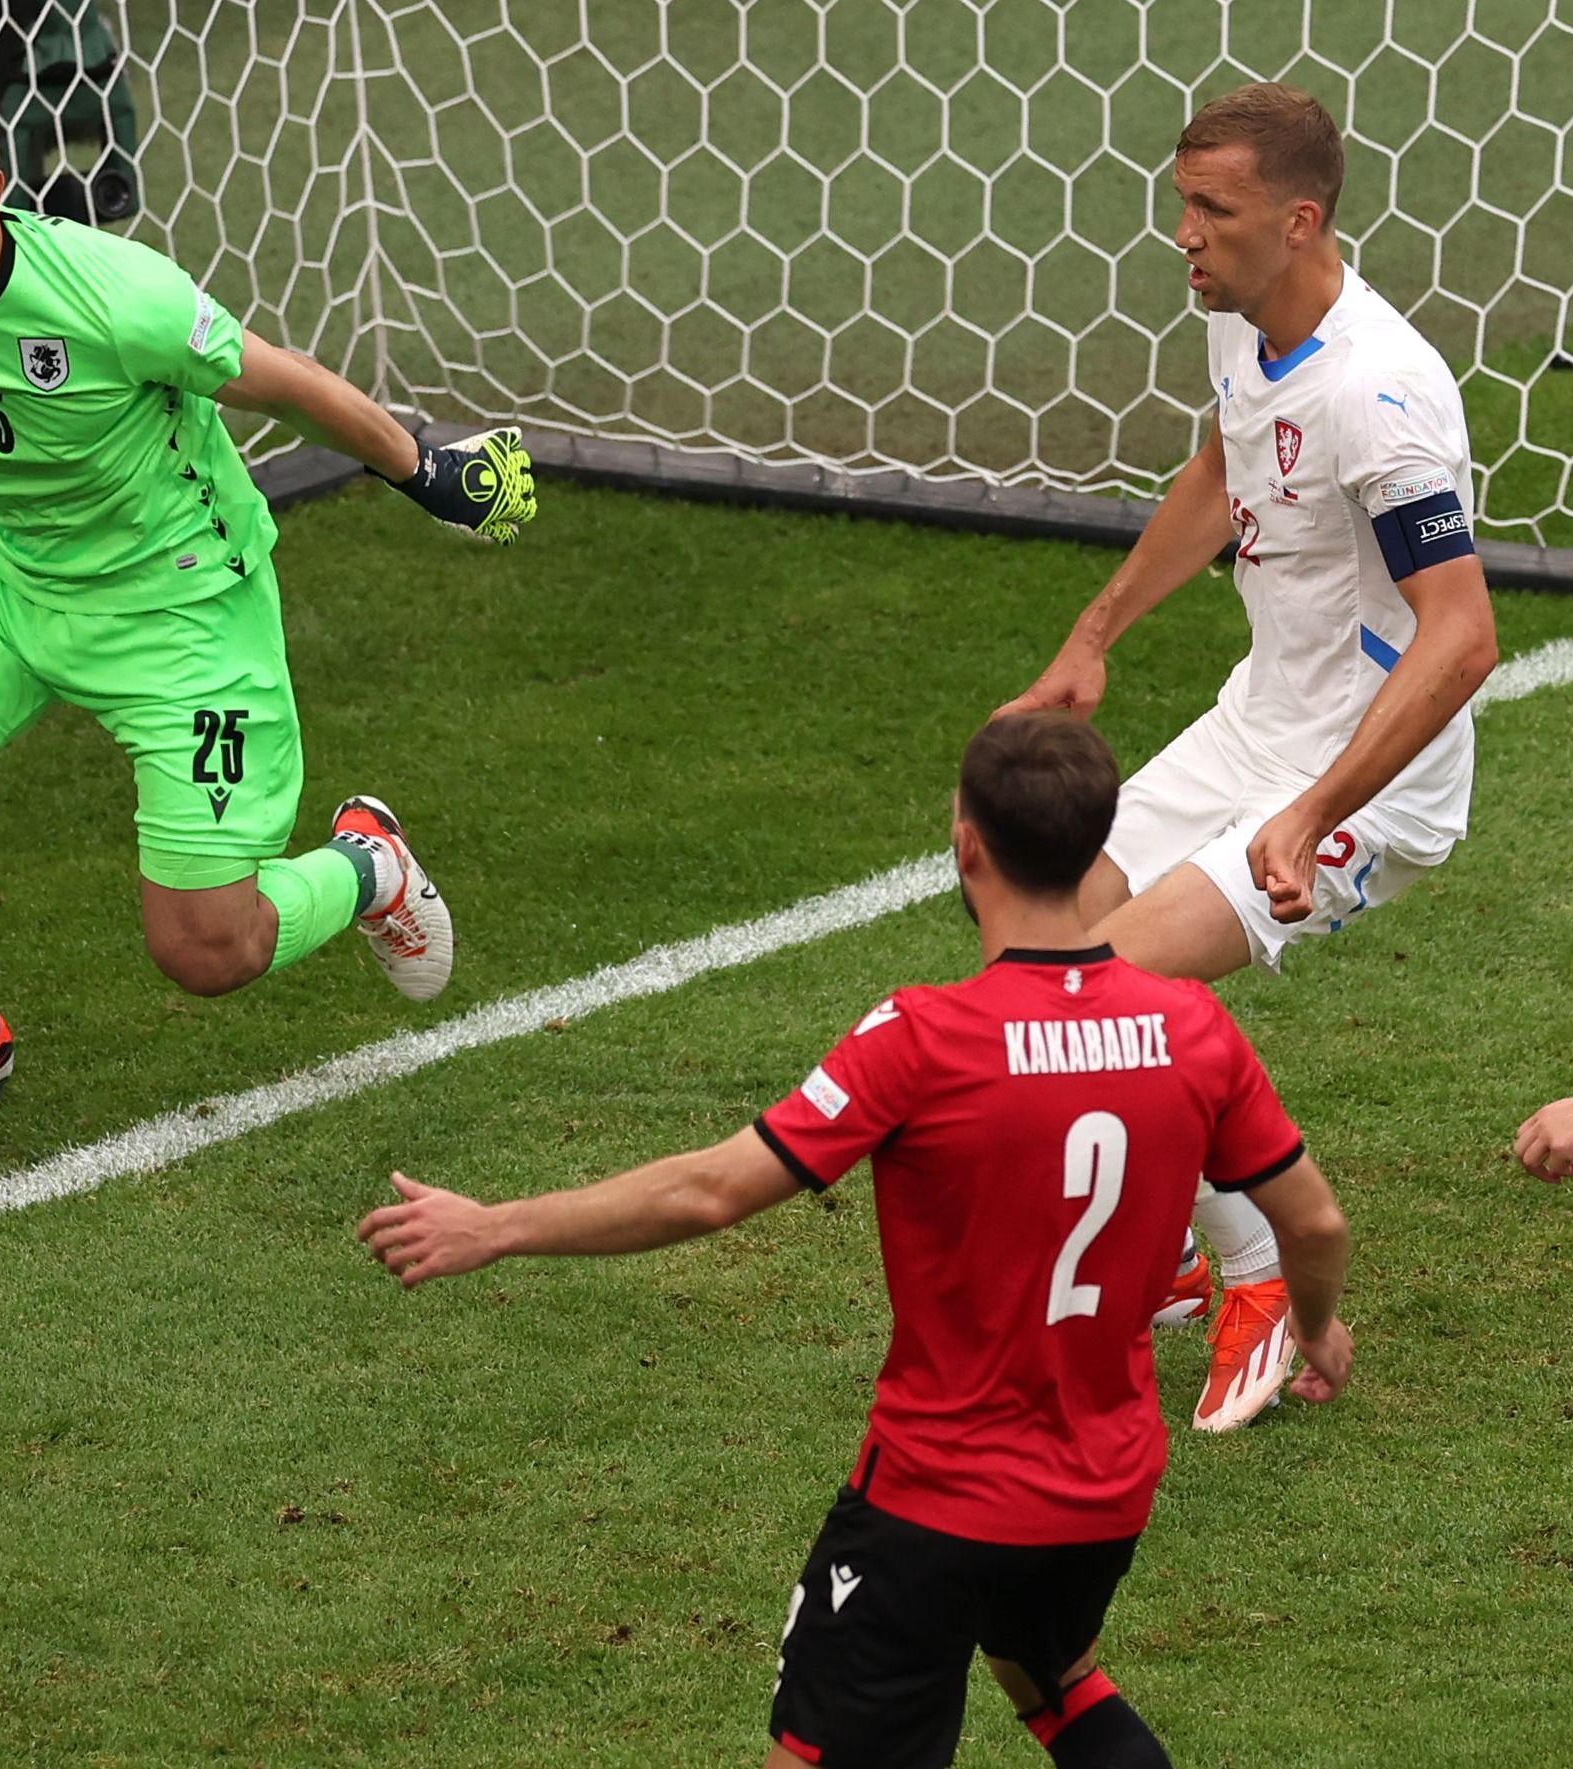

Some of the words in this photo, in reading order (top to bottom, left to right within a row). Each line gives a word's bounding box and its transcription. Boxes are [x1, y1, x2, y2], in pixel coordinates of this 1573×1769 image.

[1381, 473, 1449, 499] FOUNDATION
[1231, 497, 1261, 567] 2
[1419, 514, 1467, 539] ESPECT
[192, 709, 250, 784] 25
[1003, 1012, 1172, 1076] KAKABADZE
[1046, 1110, 1128, 1326] 2
